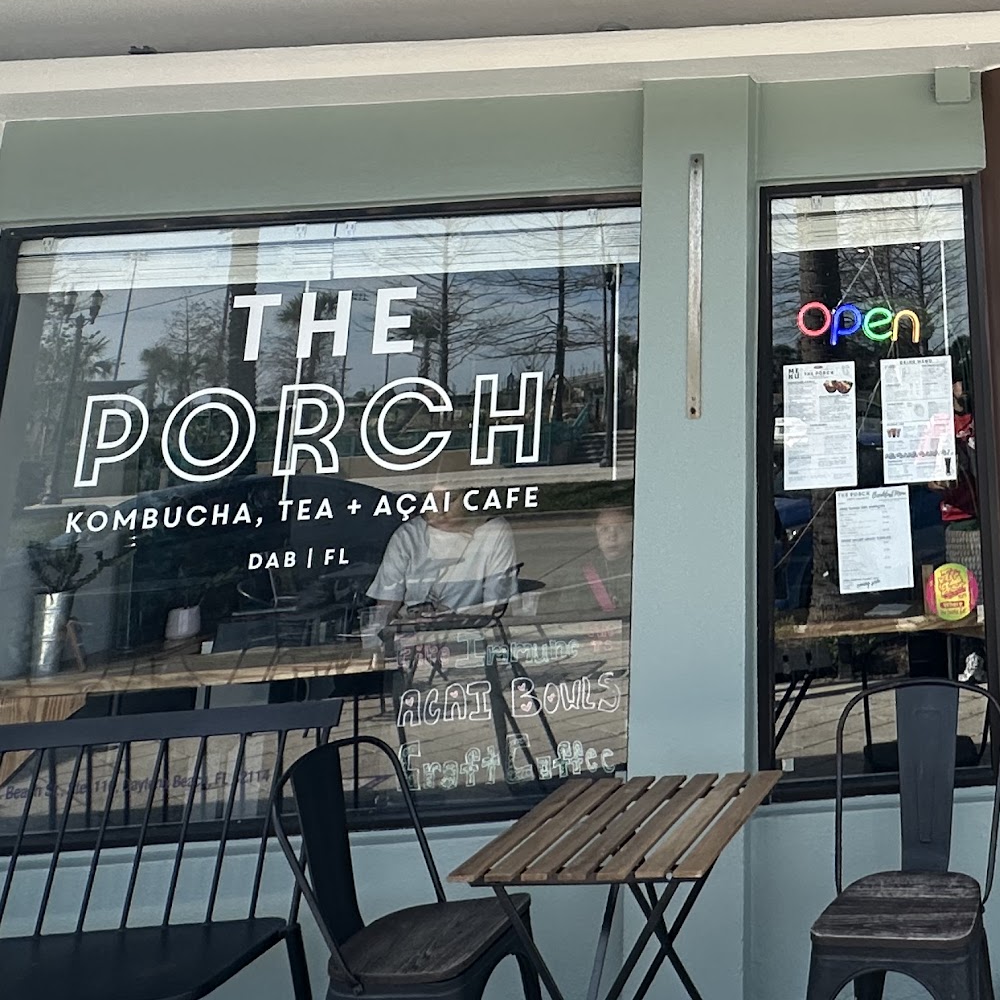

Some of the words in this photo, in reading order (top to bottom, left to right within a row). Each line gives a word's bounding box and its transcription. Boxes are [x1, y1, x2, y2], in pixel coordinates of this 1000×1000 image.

[233, 286, 418, 362] THE
[74, 371, 543, 488] PORCH
[65, 502, 264, 534] KOMBUCHA,
[278, 498, 334, 521] TEA
[347, 499, 362, 514] +
[373, 491, 451, 522] AÇAI
[463, 486, 539, 511] CAFE
[248, 551, 297, 570] DAB
[324, 548, 350, 566] FL
[511, 671, 622, 718] BOWLS
[397, 740, 501, 792] Craft
[506, 733, 616, 785] Coffee
[6, 785, 42, 799] Beah
